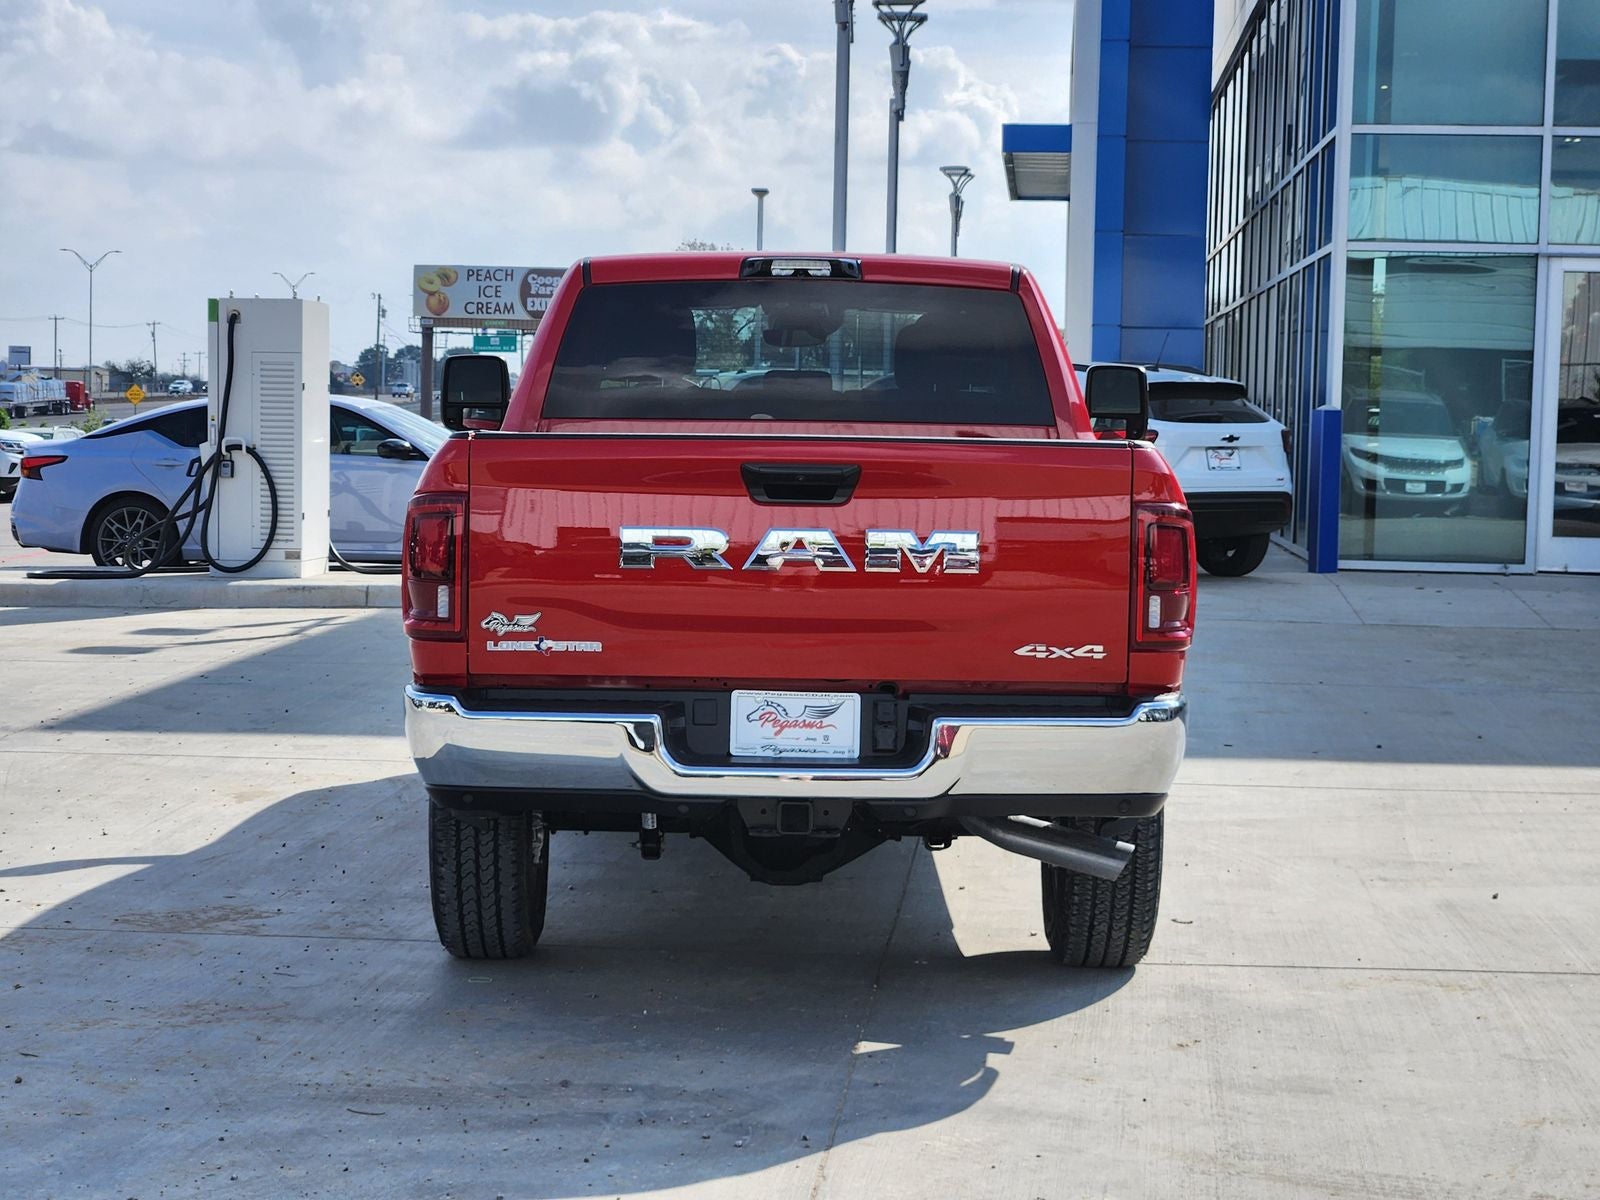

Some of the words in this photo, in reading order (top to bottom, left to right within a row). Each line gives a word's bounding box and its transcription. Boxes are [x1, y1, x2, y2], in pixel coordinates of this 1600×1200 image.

[466, 268, 514, 282] PEACH
[478, 285, 502, 298] ICE
[464, 301, 515, 315] CREAM
[619, 525, 981, 574] RAM
[486, 640, 537, 652] LONE
[553, 640, 603, 652] STAR
[1013, 643, 1108, 660] 4x4
[759, 711, 838, 737] Pegasus
